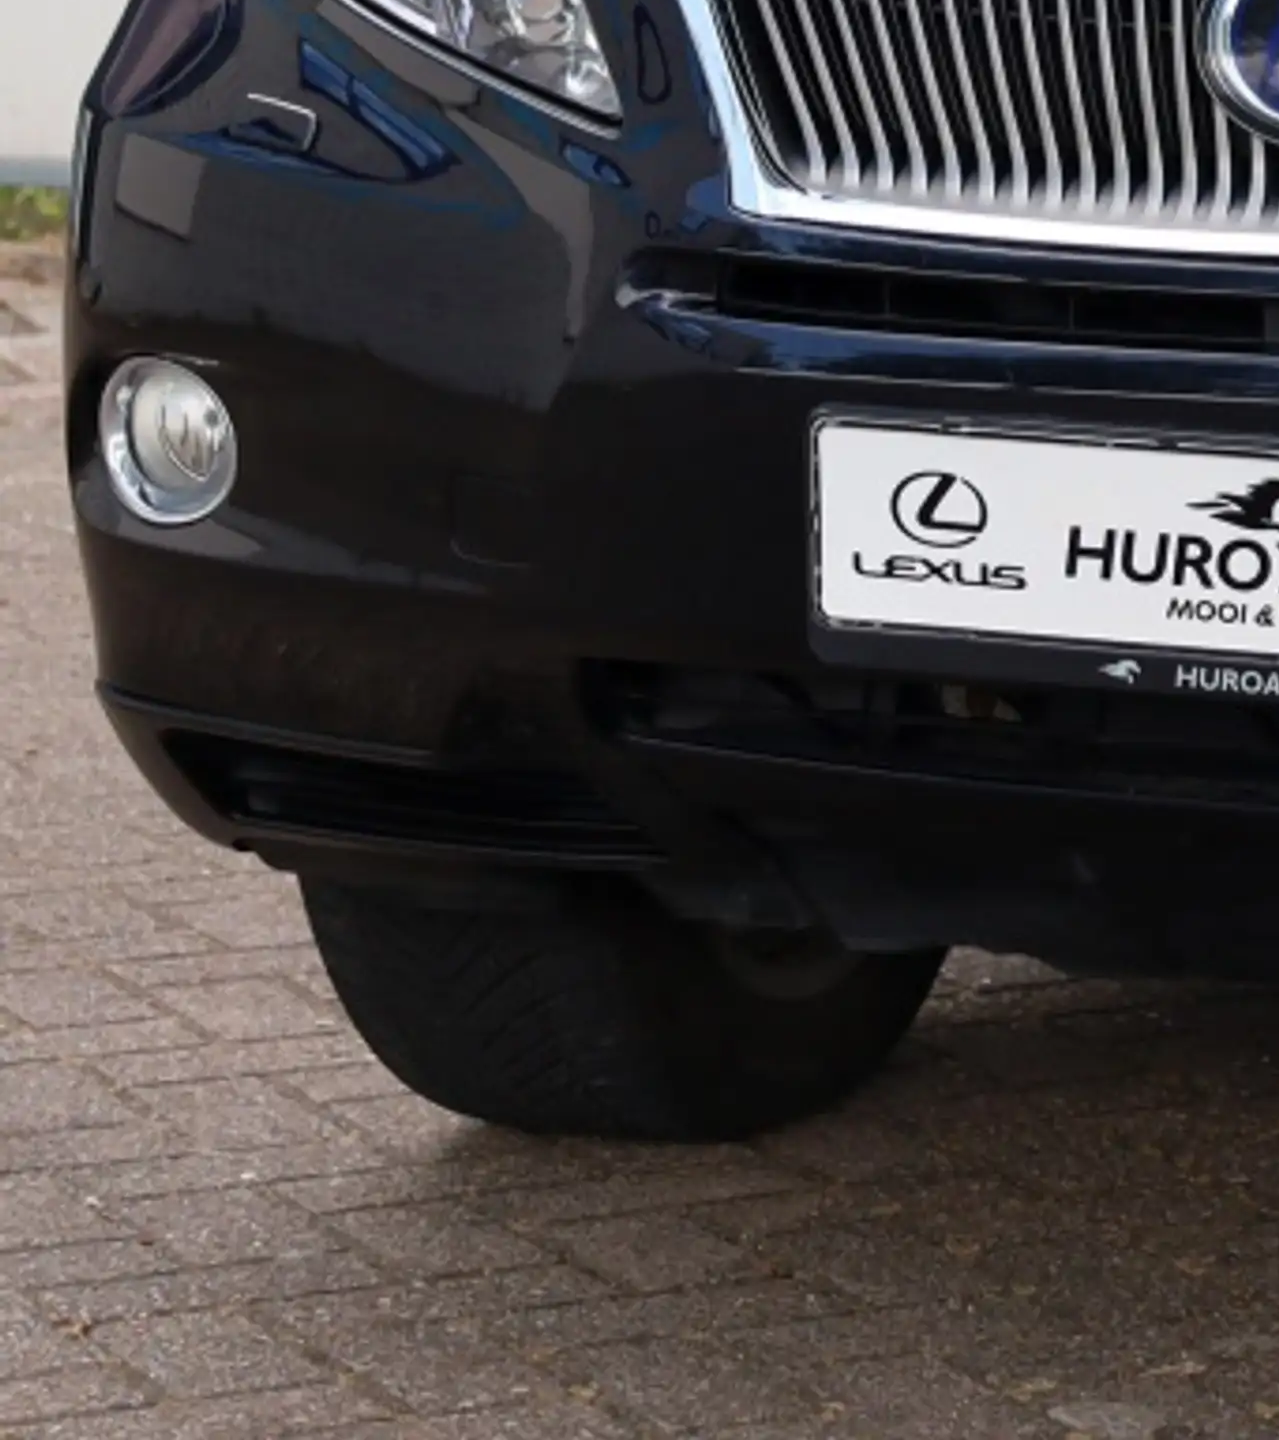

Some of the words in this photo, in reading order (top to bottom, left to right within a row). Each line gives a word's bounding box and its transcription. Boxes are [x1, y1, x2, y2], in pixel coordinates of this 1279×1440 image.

[853, 551, 1027, 591] LEXUS
[1166, 598, 1247, 624] MOOI
[1254, 605, 1275, 627] &
